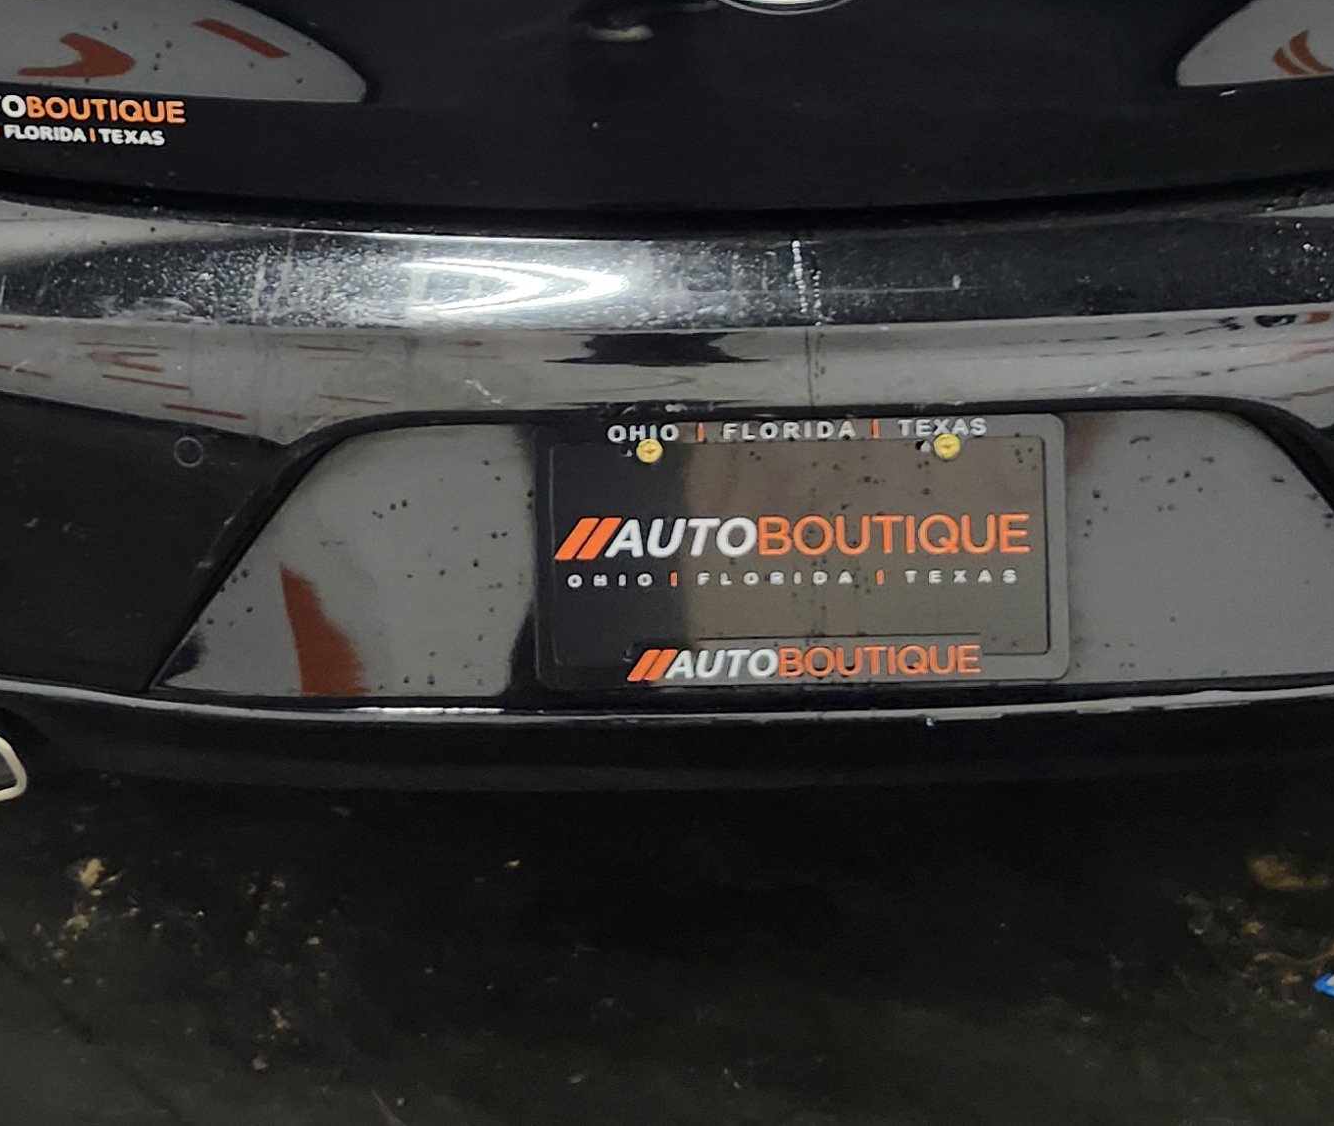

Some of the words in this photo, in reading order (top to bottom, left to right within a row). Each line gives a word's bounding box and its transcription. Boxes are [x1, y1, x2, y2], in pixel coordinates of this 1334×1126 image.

[3, 123, 87, 143] FLORIDA
[99, 127, 165, 146] TEXAS
[607, 423, 680, 443] OHIO
[722, 420, 857, 441] FLORIDA
[897, 416, 988, 438] TEXAS
[566, 572, 654, 588] OHIO
[697, 570, 854, 586] FLORIDA
[905, 568, 1019, 585] TEXAS
